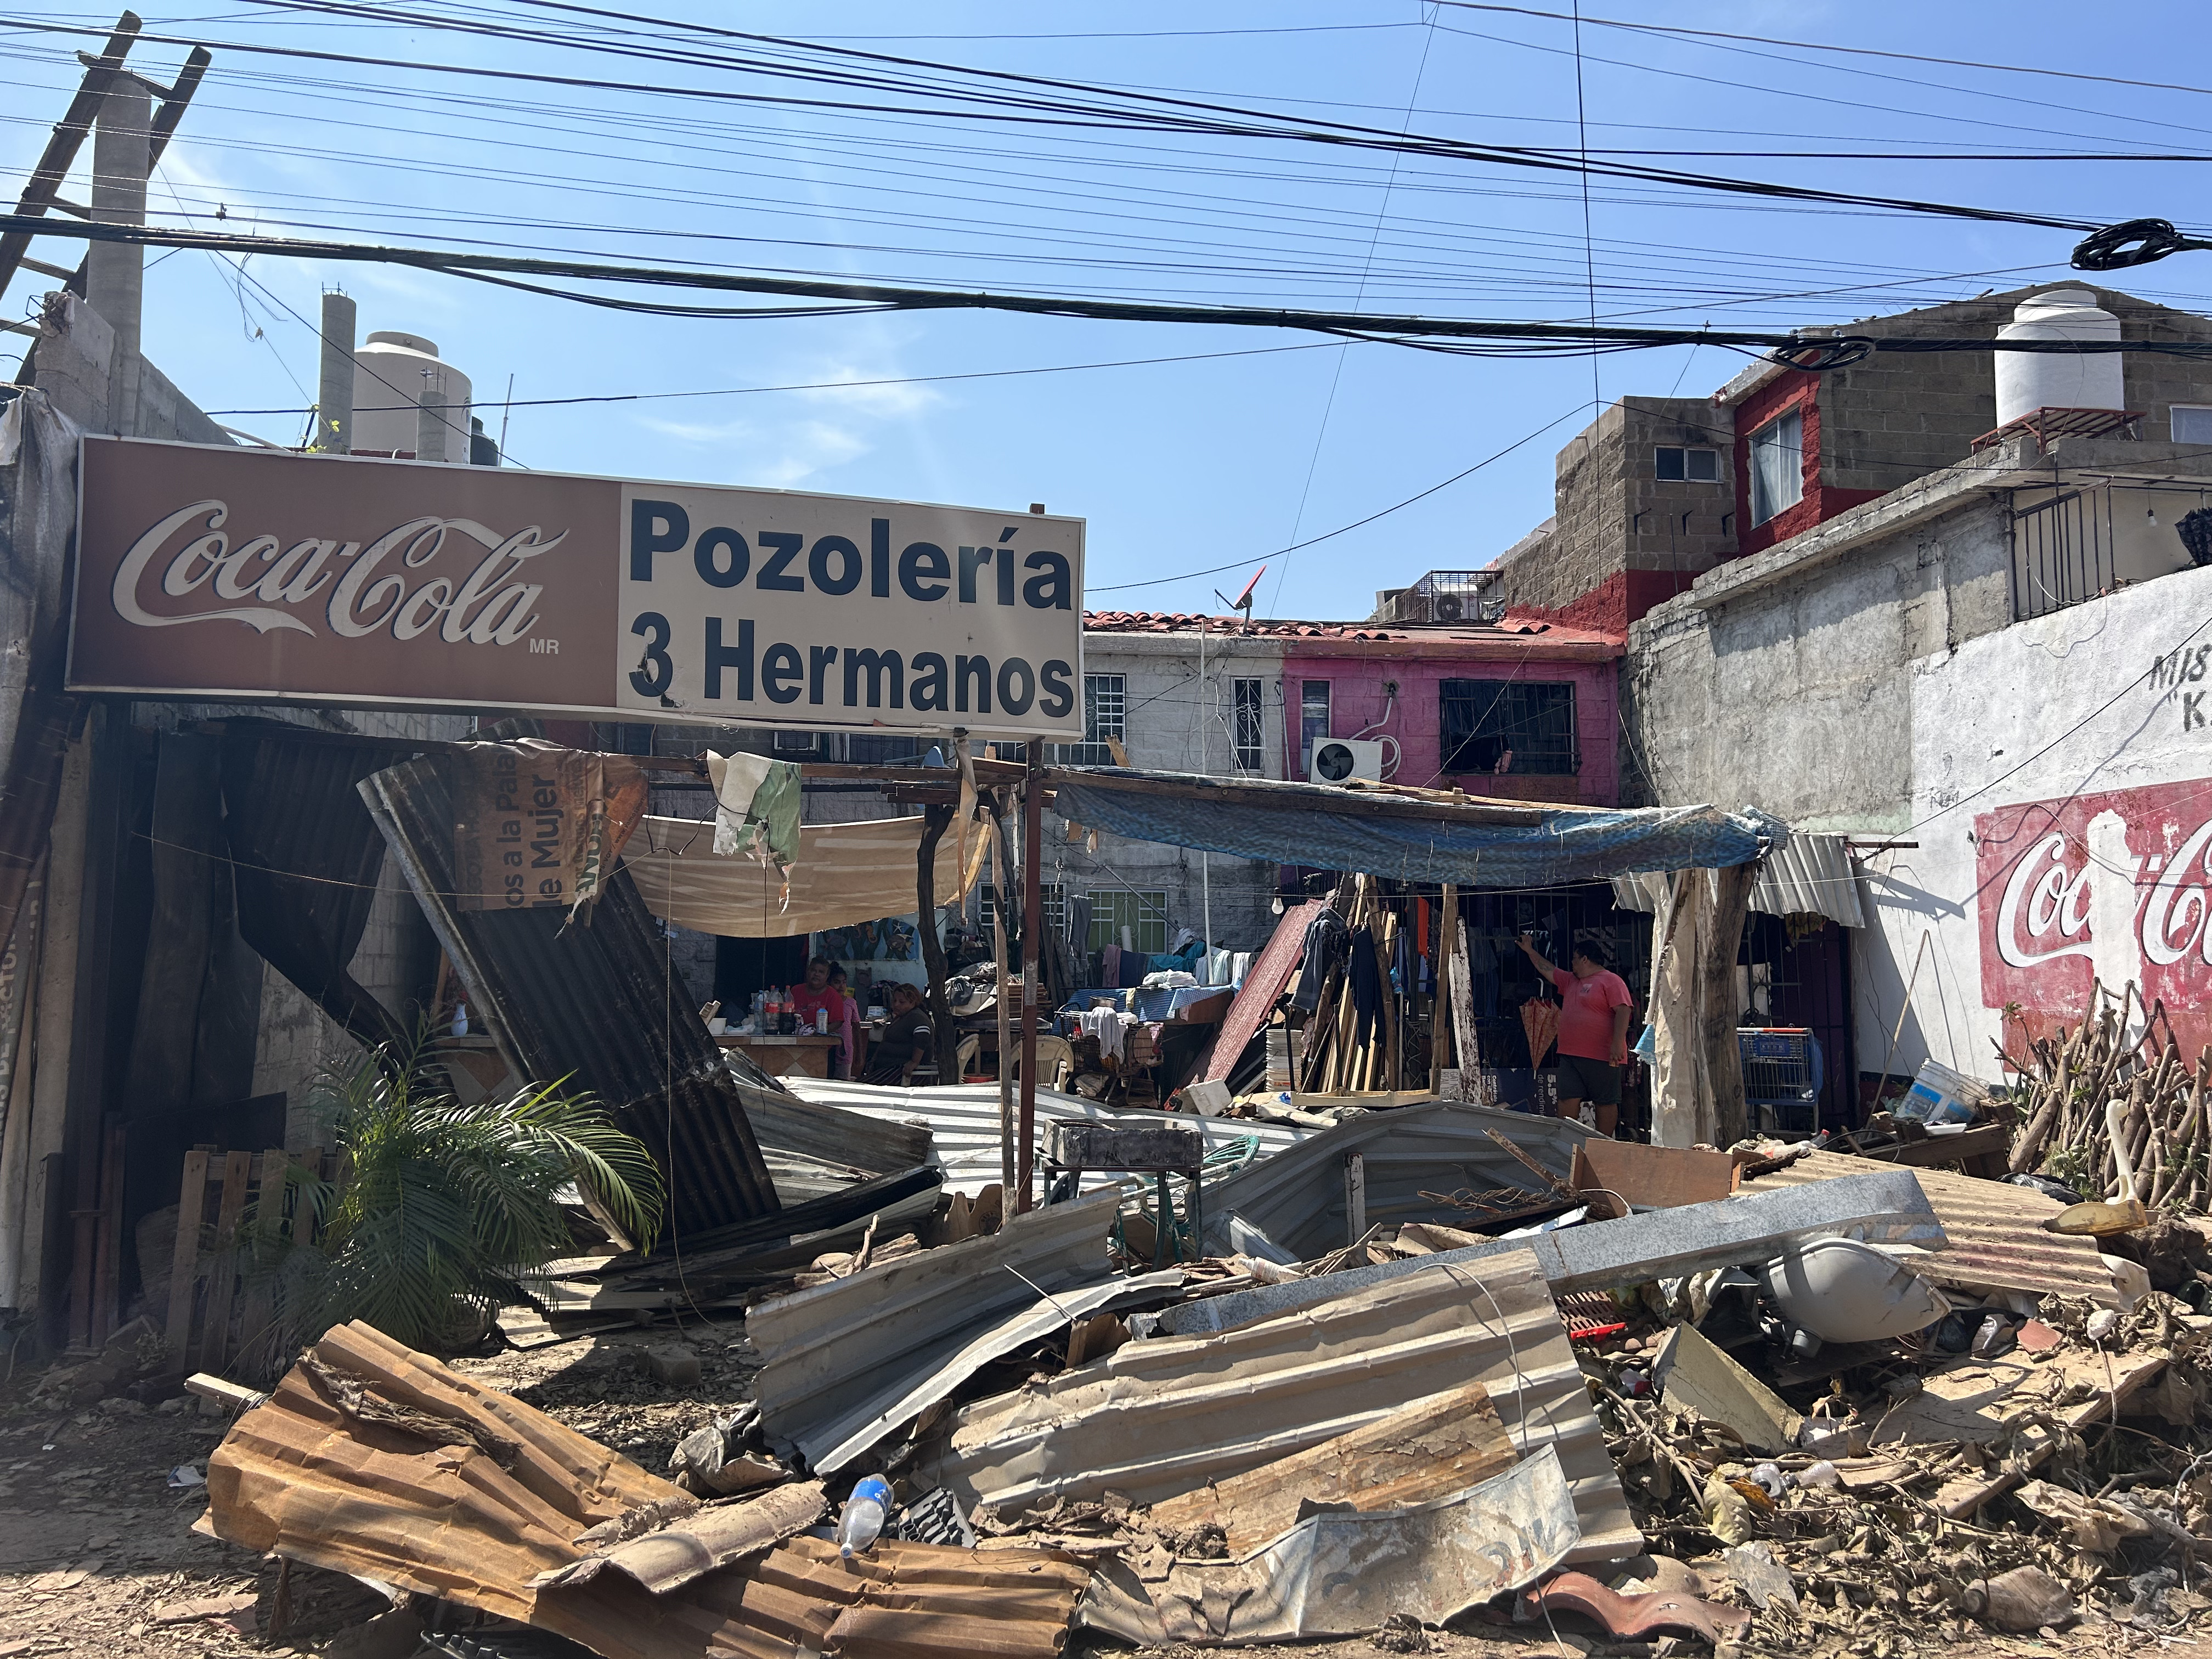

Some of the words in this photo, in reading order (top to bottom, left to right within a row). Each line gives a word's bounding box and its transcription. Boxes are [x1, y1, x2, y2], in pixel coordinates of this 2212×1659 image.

[630, 498, 1071, 611] Pozolería
[112, 499, 569, 646] Coca-Cola
[529, 637, 560, 655] MR
[629, 612, 674, 698] 3
[704, 617, 1074, 718] Hermanos
[492, 744, 519, 811] Pala
[496, 820, 521, 843] la
[527, 774, 564, 868] Mujer
[503, 851, 522, 867] a
[504, 873, 525, 909] os
[1449, 1071, 1458, 1082] GAT
[1538, 1074, 1544, 1084] de
[1547, 1074, 1558, 1105] 5.5%
